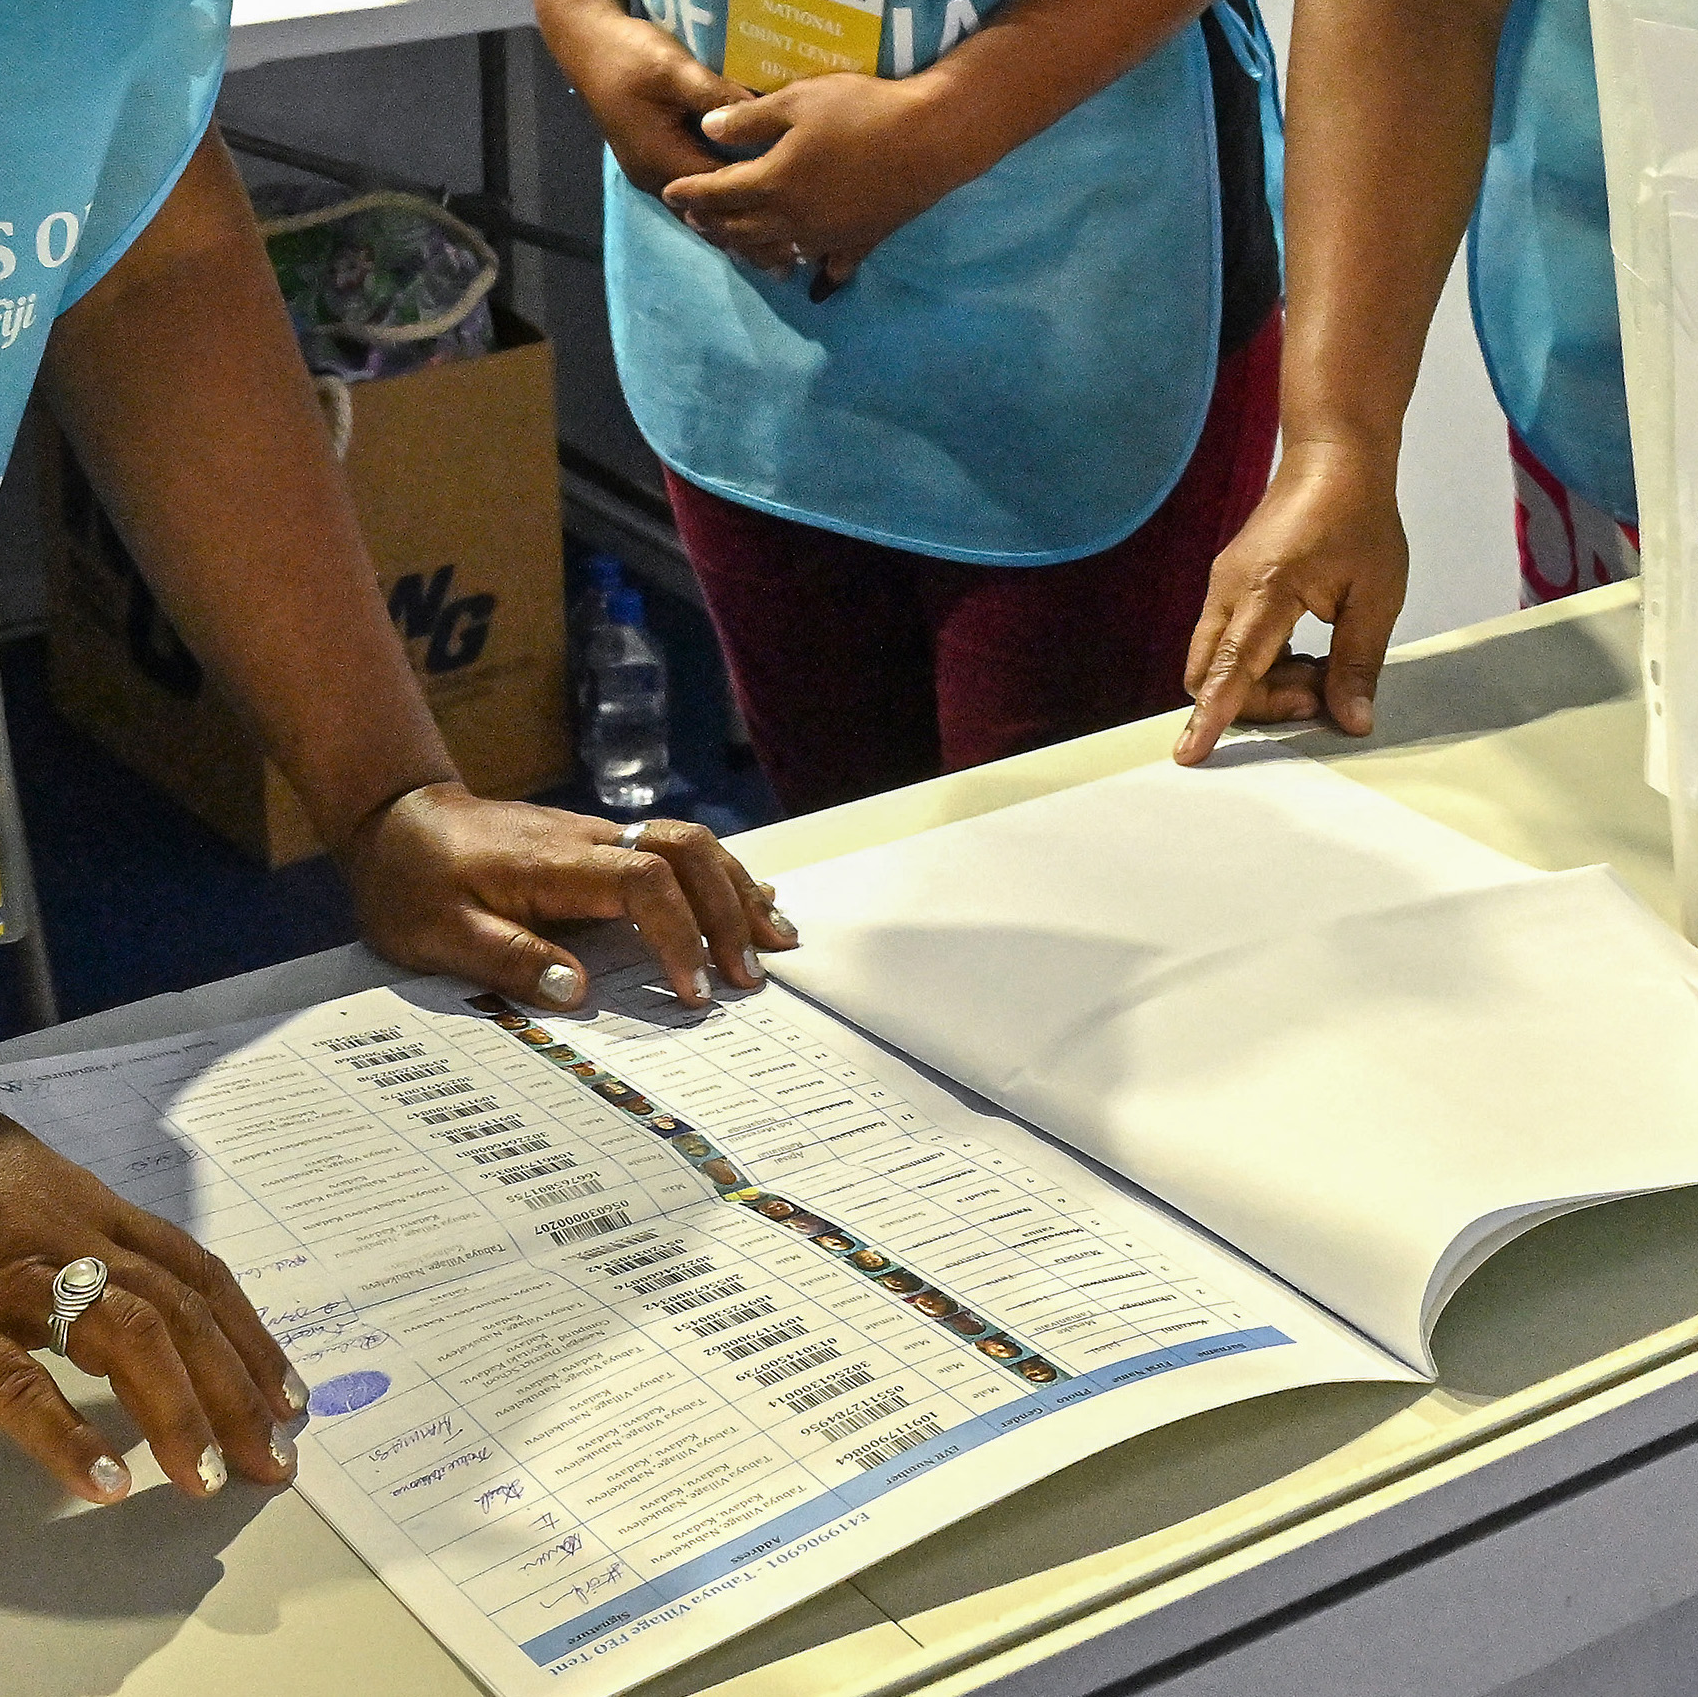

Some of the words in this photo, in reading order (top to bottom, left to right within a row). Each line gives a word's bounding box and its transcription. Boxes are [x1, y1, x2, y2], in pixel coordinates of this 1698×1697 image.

[1197, 1342, 1247, 1358] Surname
[1111, 1368, 1142, 1384] Name
[971, 1382, 999, 1402] Male
[1056, 1388, 1091, 1406] Photo
[1000, 1406, 1044, 1429] Gender
[833, 1408, 939, 1467] 109117900864
[886, 1451, 933, 1486] Number
[935, 1444, 960, 1463] EVR
[714, 1490, 764, 1522] Kadavu,
[760, 1481, 807, 1511] Tabuya
[670, 1514, 717, 1544] Kadavu
[716, 1502, 764, 1533] Village,
[648, 1525, 720, 1567] Nabukelevu
[728, 1533, 783, 1567] Address
[689, 1567, 756, 1608] Tabuya
[565, 1608, 632, 1648] Signature
[628, 1599, 691, 1638] Village
[593, 1632, 630, 1658] FEO
[547, 1649, 591, 1679] Tent
